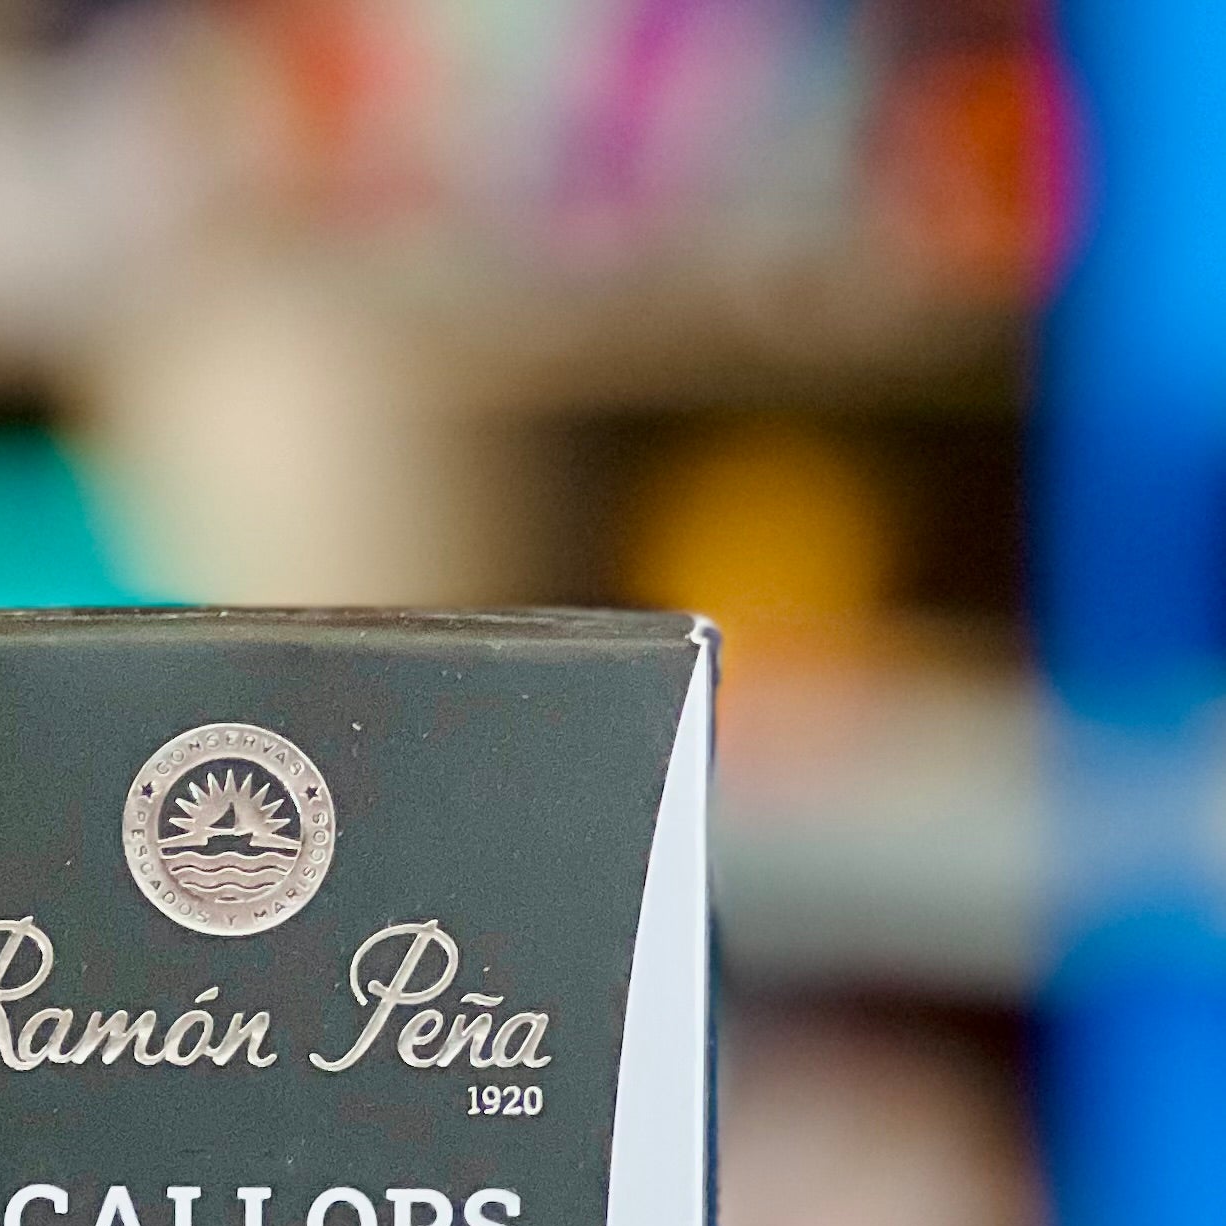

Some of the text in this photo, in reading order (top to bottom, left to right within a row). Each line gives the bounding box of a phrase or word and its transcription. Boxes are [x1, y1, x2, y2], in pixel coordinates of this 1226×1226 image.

[155, 731, 304, 777] CONSERVAS
[130, 810, 328, 926] PESCADOS Y MARISCOS
[309, 918, 552, 1072] Peña
[466, 1085, 544, 1116] 1920
